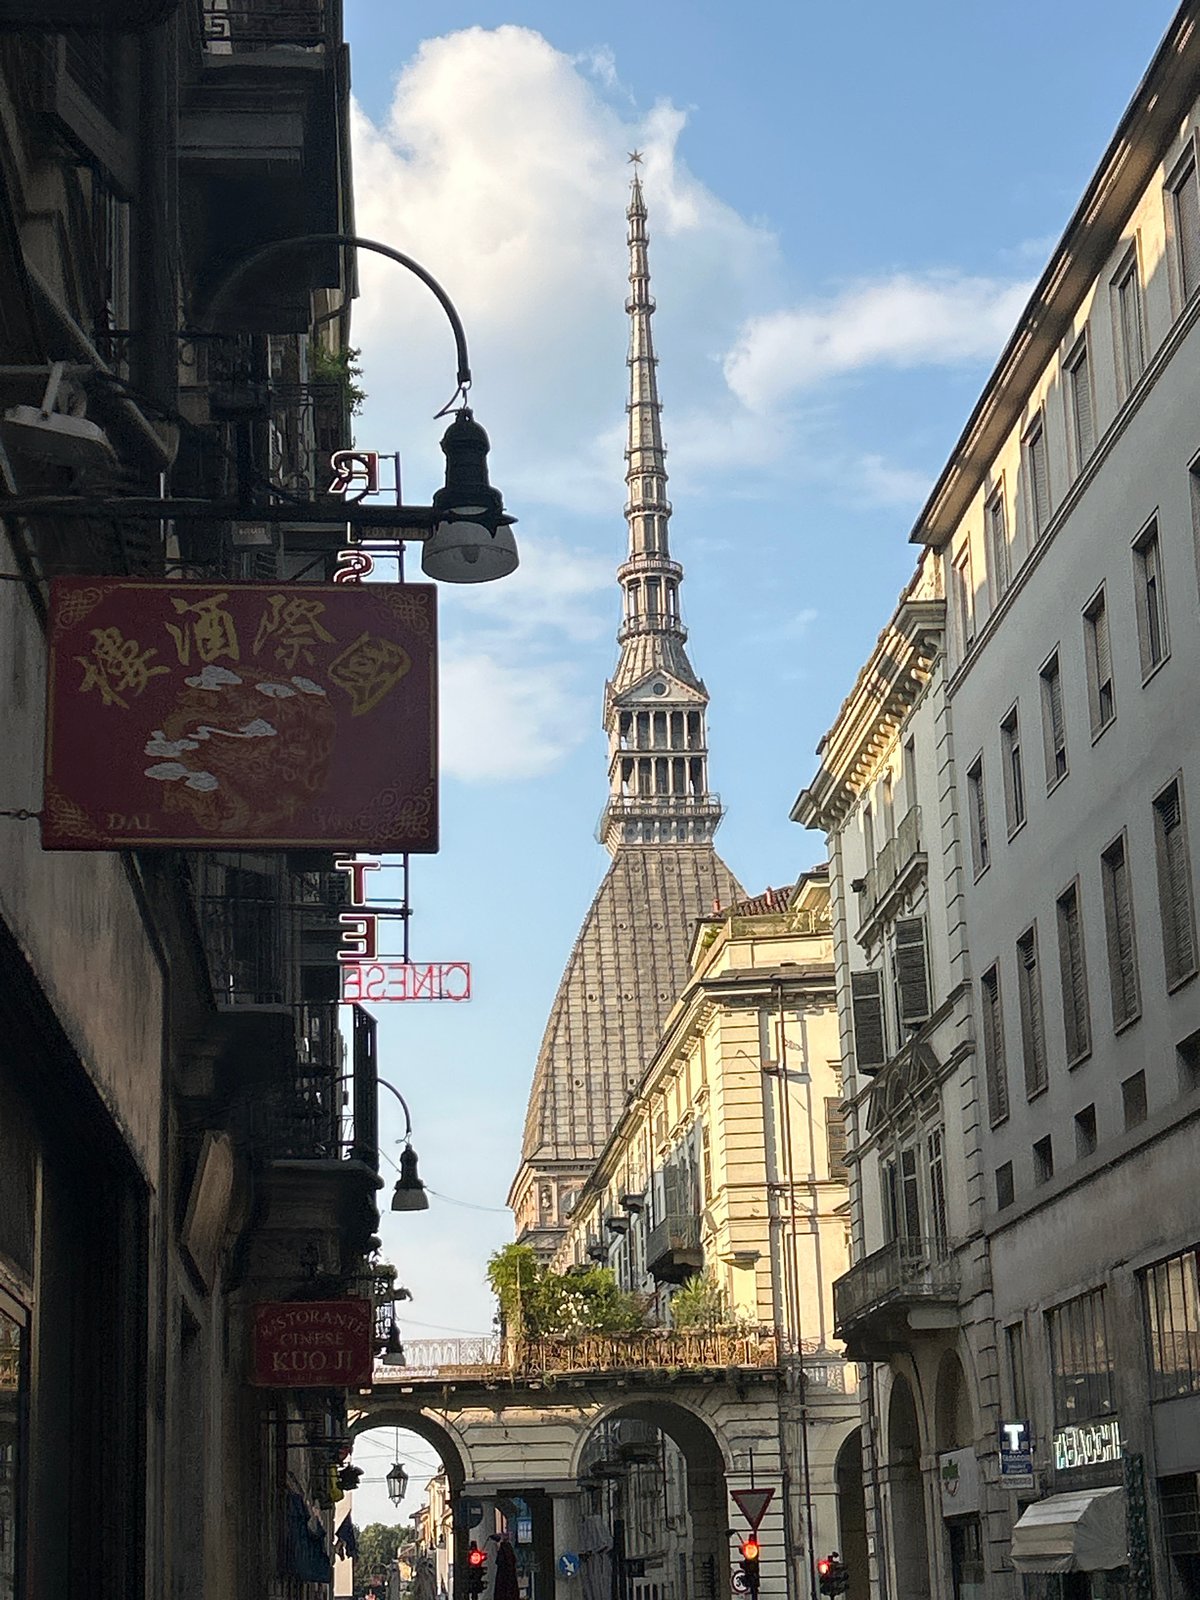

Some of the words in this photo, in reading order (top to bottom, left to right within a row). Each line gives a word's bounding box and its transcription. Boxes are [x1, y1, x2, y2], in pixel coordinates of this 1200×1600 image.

[261, 1309, 366, 1337] RISTORANTE
[280, 1331, 345, 1346] CINESE
[272, 1350, 327, 1371] KUO
[1004, 1424, 1024, 1451] T
